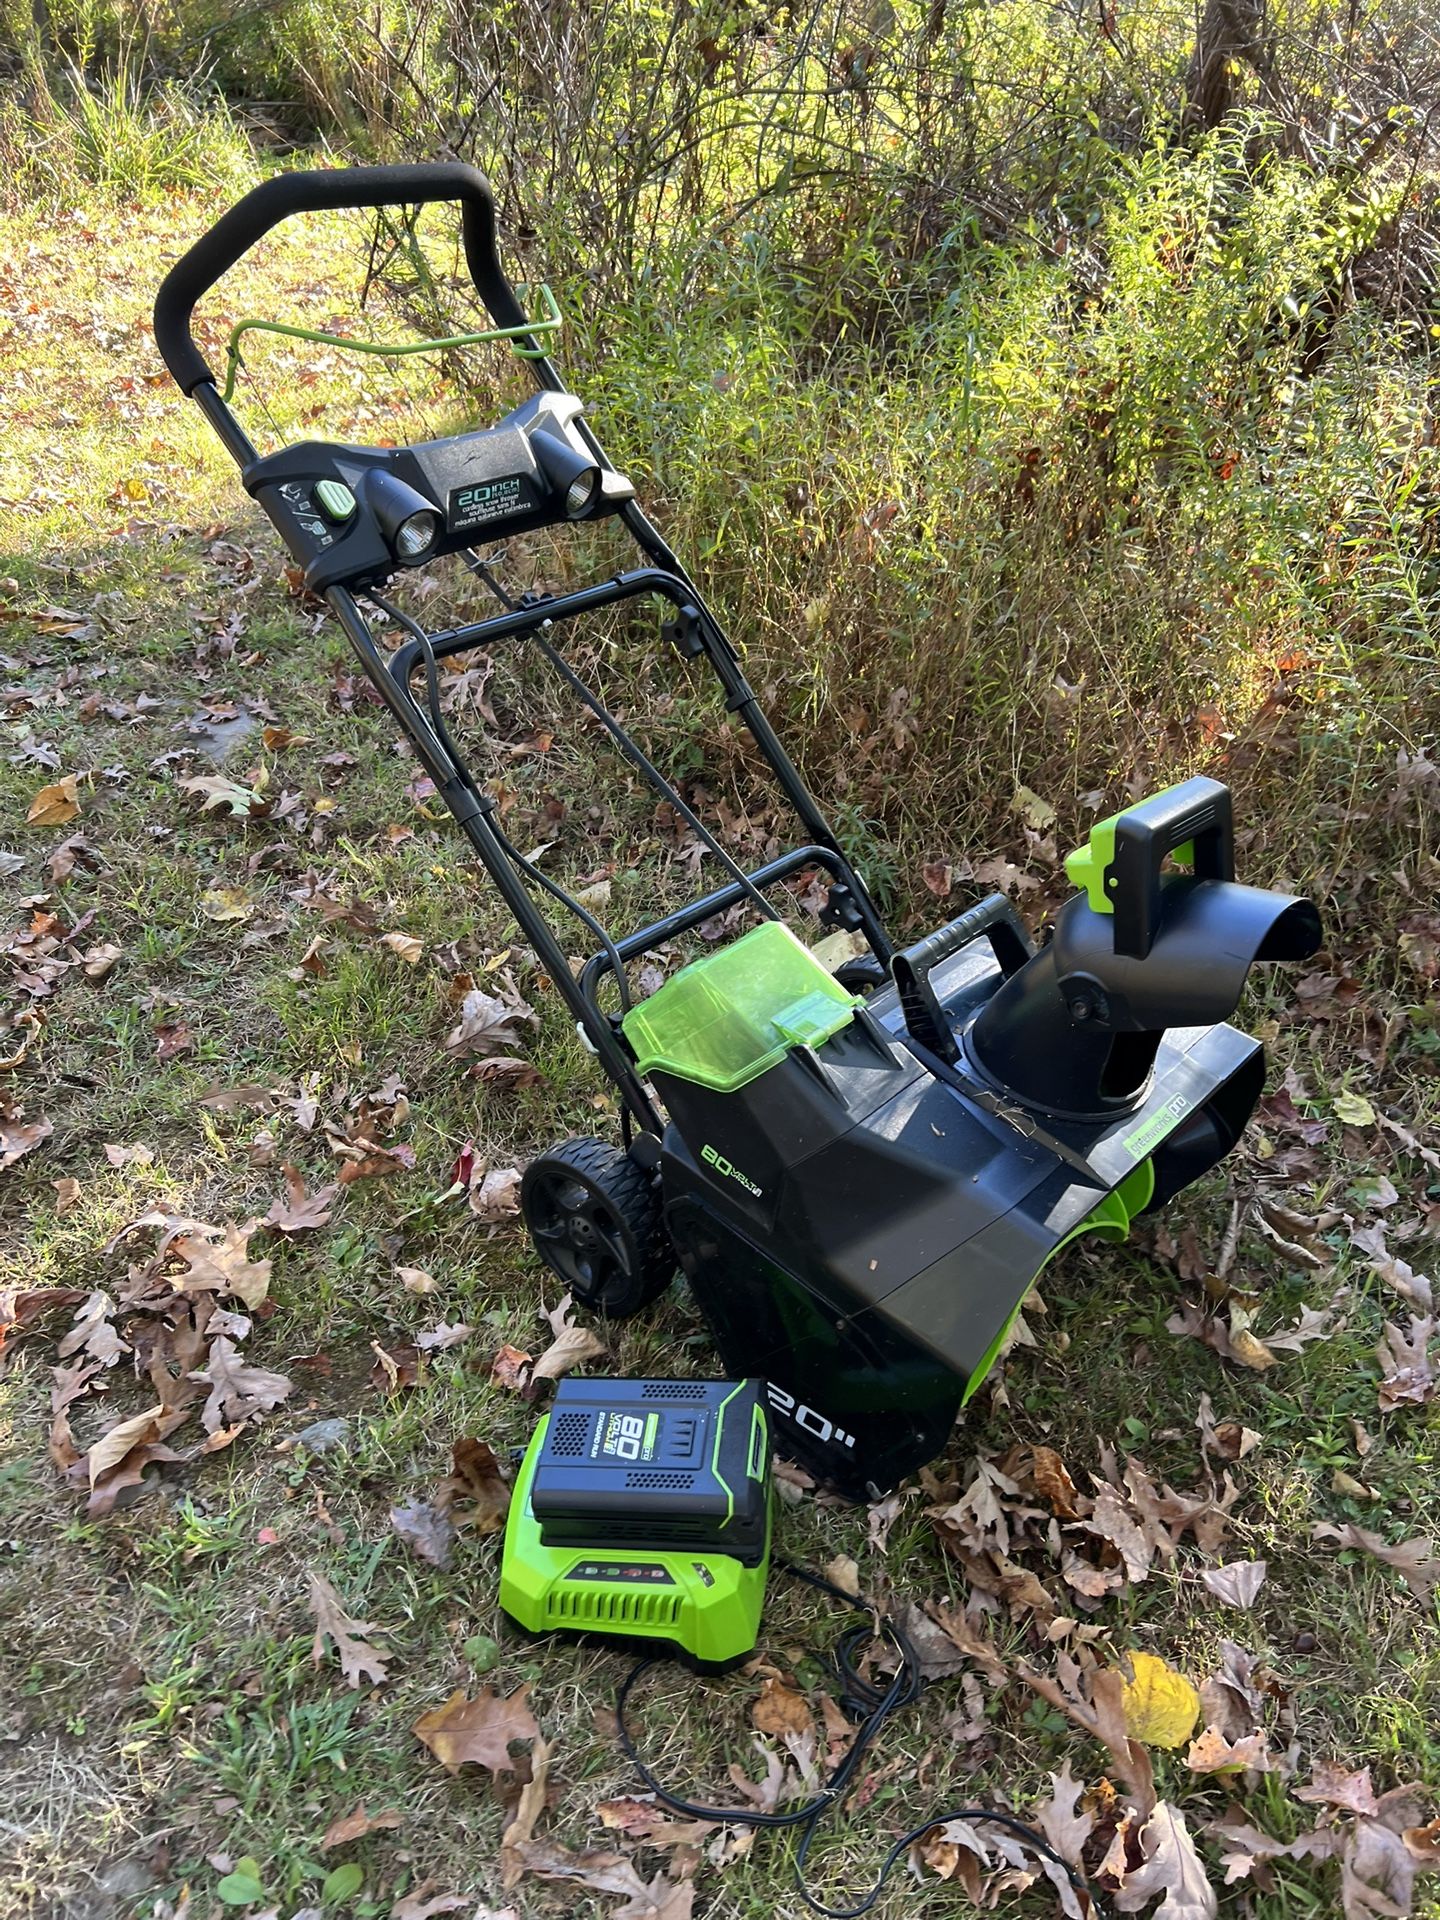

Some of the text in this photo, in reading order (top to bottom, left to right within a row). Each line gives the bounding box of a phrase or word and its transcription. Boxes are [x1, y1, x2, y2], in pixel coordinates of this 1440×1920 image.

[458, 487, 490, 506] 20
[462, 503, 484, 513] cordless
[500, 494, 519, 503] thrower
[497, 502, 510, 510] sans
[1130, 1096, 1187, 1155] greenworks pro
[701, 1144, 733, 1176] 80
[590, 1411, 606, 1458] STANDARD RUN
[616, 1415, 644, 1460] 80
